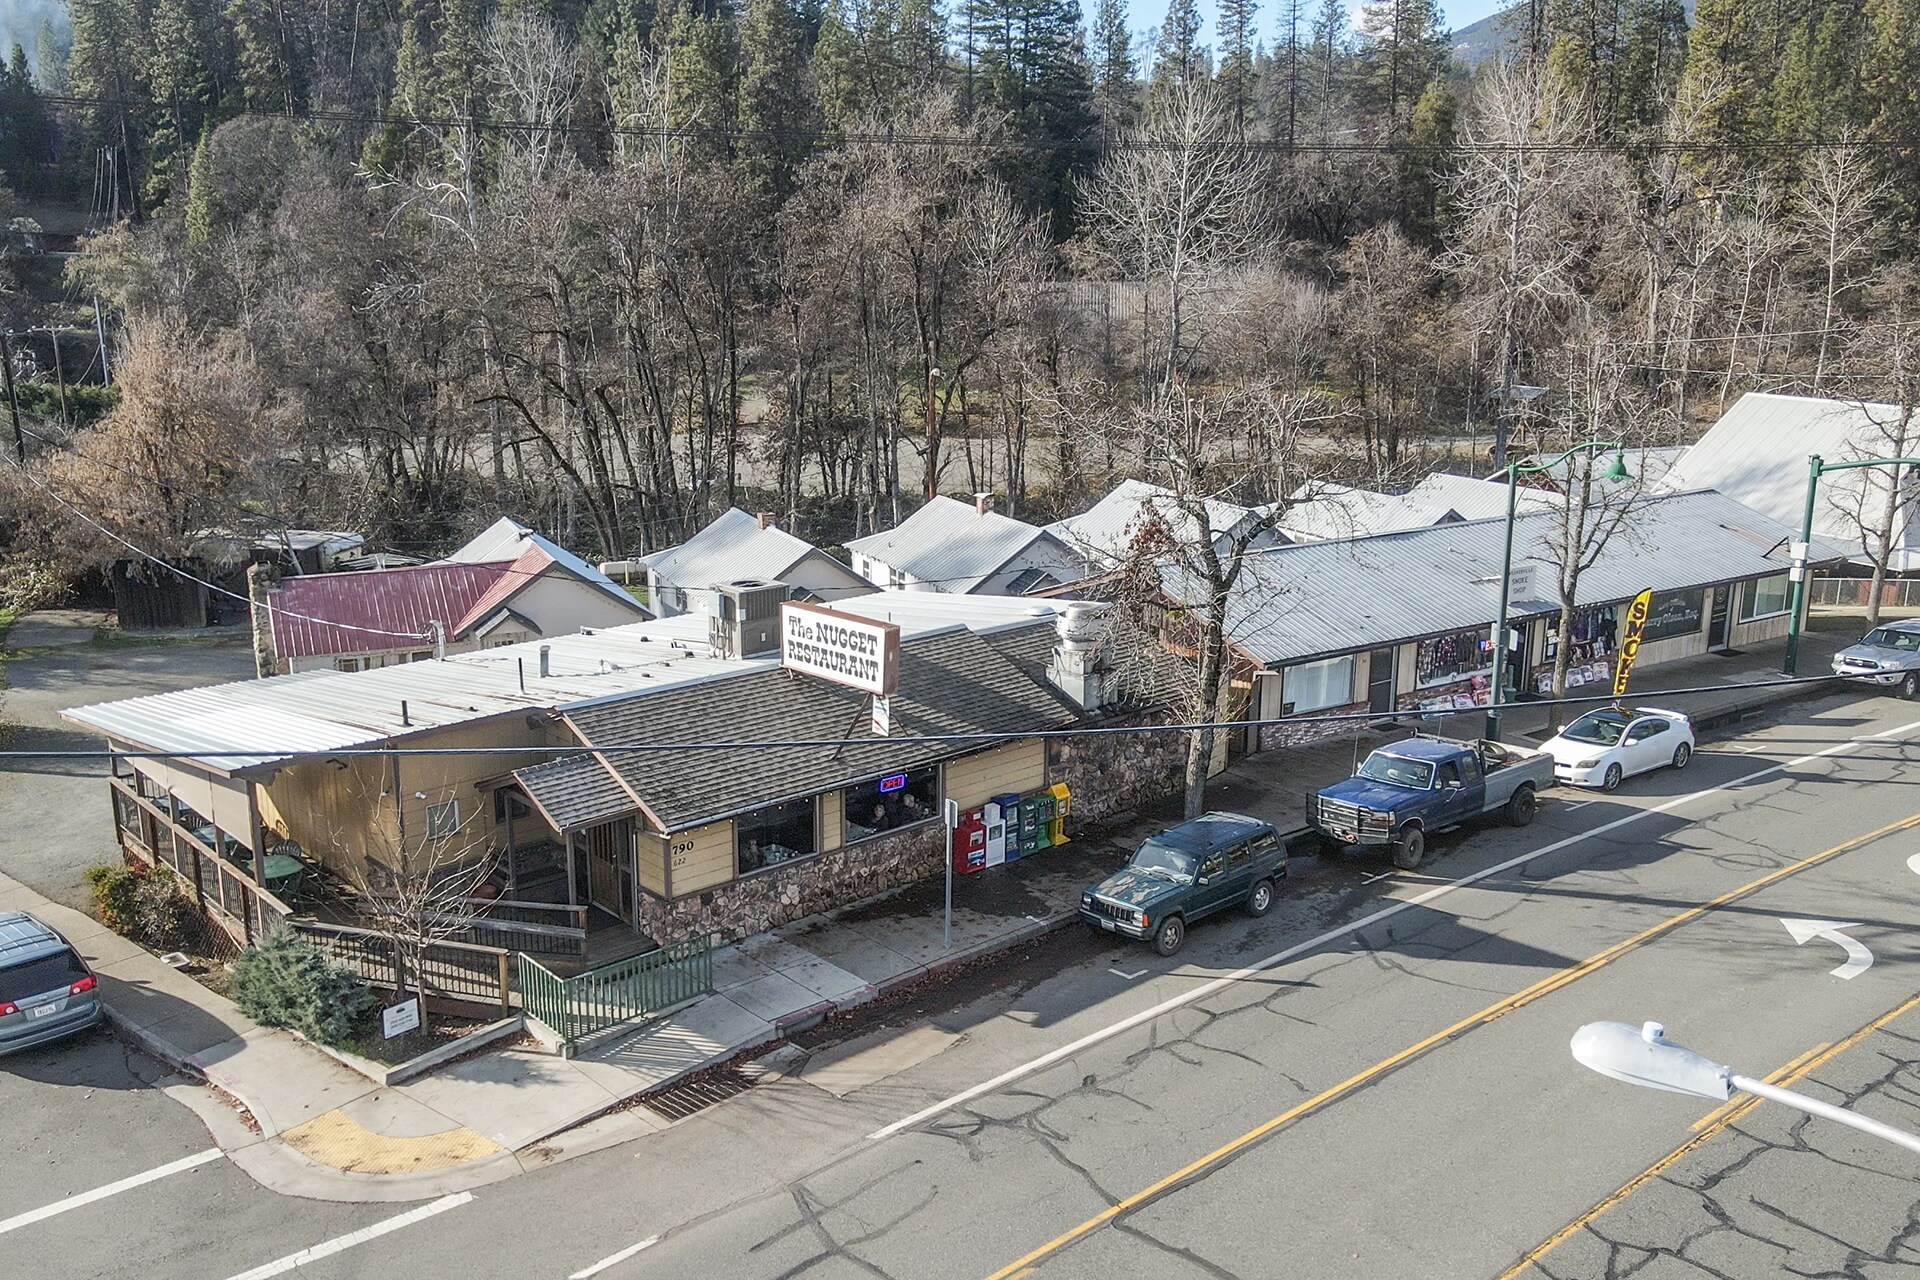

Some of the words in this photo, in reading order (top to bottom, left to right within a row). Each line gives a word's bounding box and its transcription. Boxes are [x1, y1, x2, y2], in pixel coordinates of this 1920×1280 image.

[788, 615, 813, 640] The
[816, 621, 878, 656] NUGGET
[1616, 602, 1646, 693] SMOKE
[787, 639, 879, 682] RESTAURANT
[672, 840, 694, 856] 790
[673, 857, 687, 867] 622
